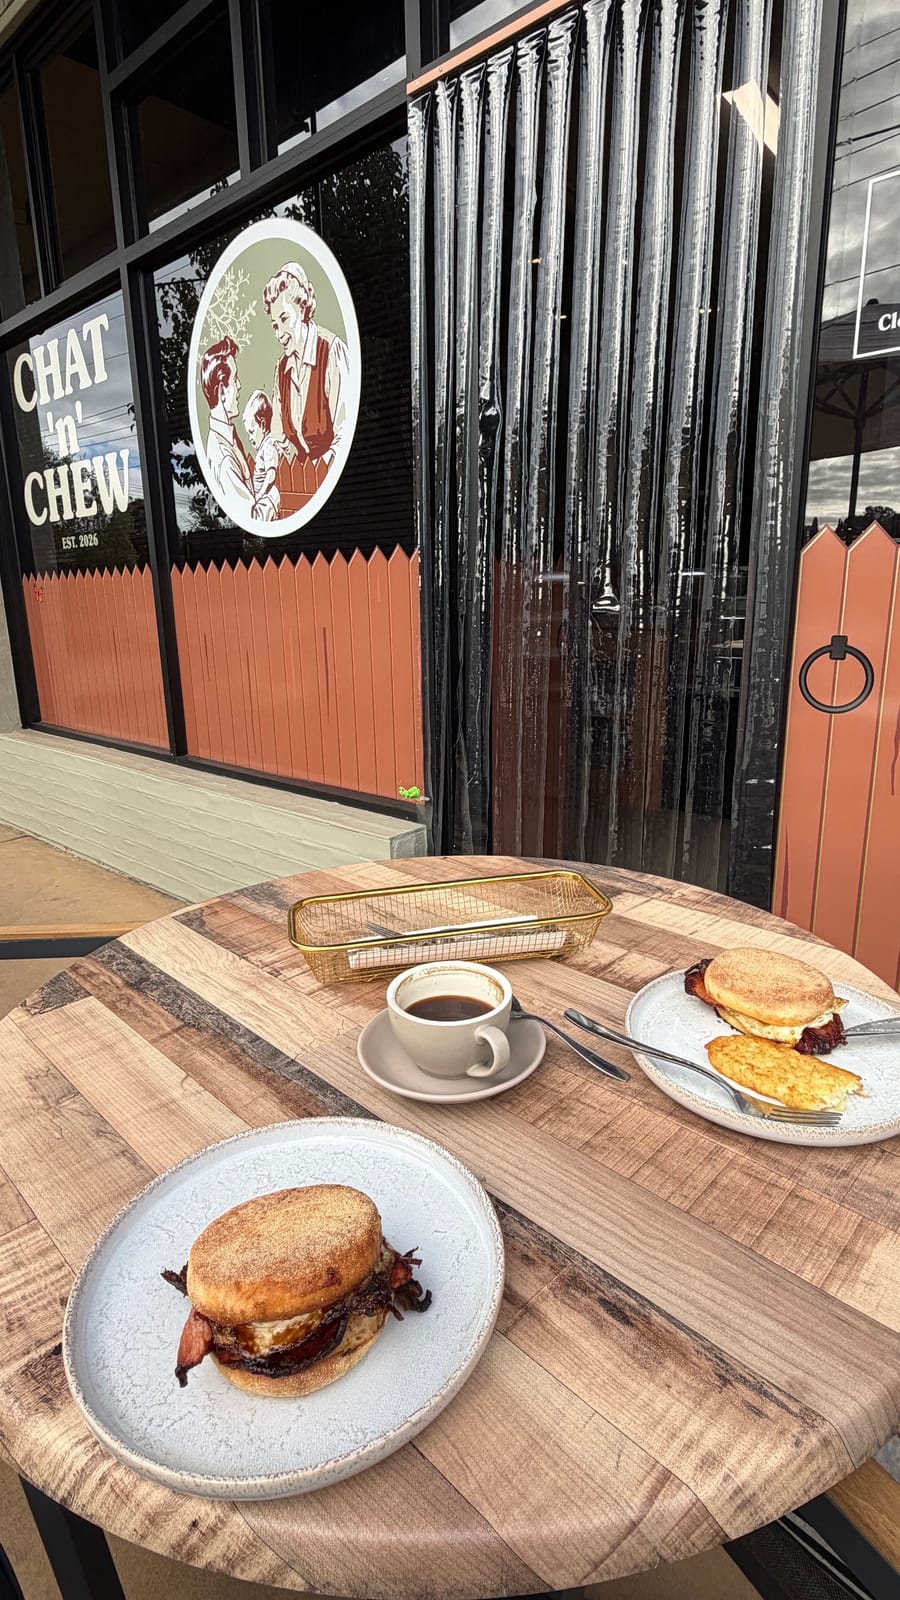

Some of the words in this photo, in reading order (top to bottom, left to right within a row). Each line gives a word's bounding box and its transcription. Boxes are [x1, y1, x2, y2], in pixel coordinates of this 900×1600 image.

[878, 311, 900, 331] Cl
[13, 313, 109, 412] CHAT
[46, 400, 82, 456] 'n'
[24, 448, 130, 526] CHEW
[61, 536, 78, 550] EST.
[79, 533, 99, 548] 2026
